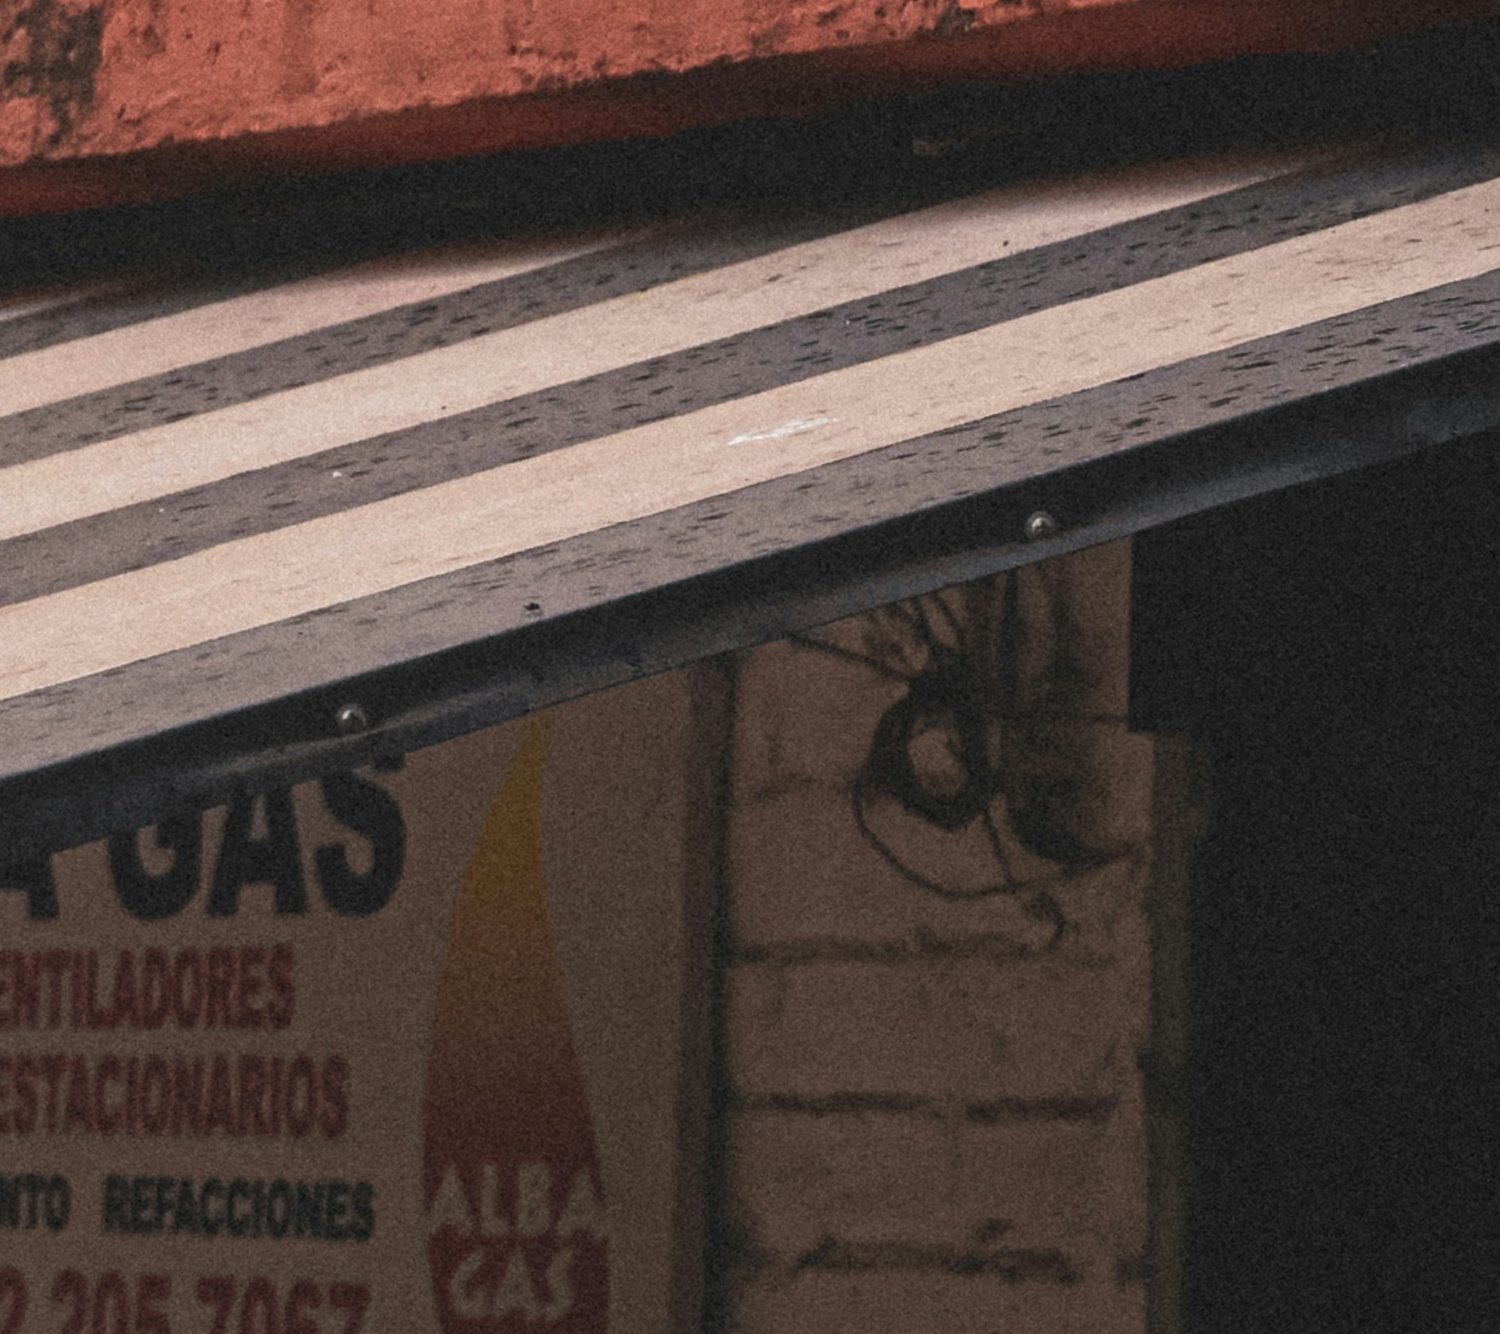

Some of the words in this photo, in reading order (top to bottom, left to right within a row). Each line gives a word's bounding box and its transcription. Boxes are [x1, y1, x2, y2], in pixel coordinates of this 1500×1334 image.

[105, 757, 406, 921] GAS
[102, 1174, 377, 1244] REFACCIONES
[426, 1161, 612, 1243] ALBA
[447, 1245, 576, 1325] GAS
